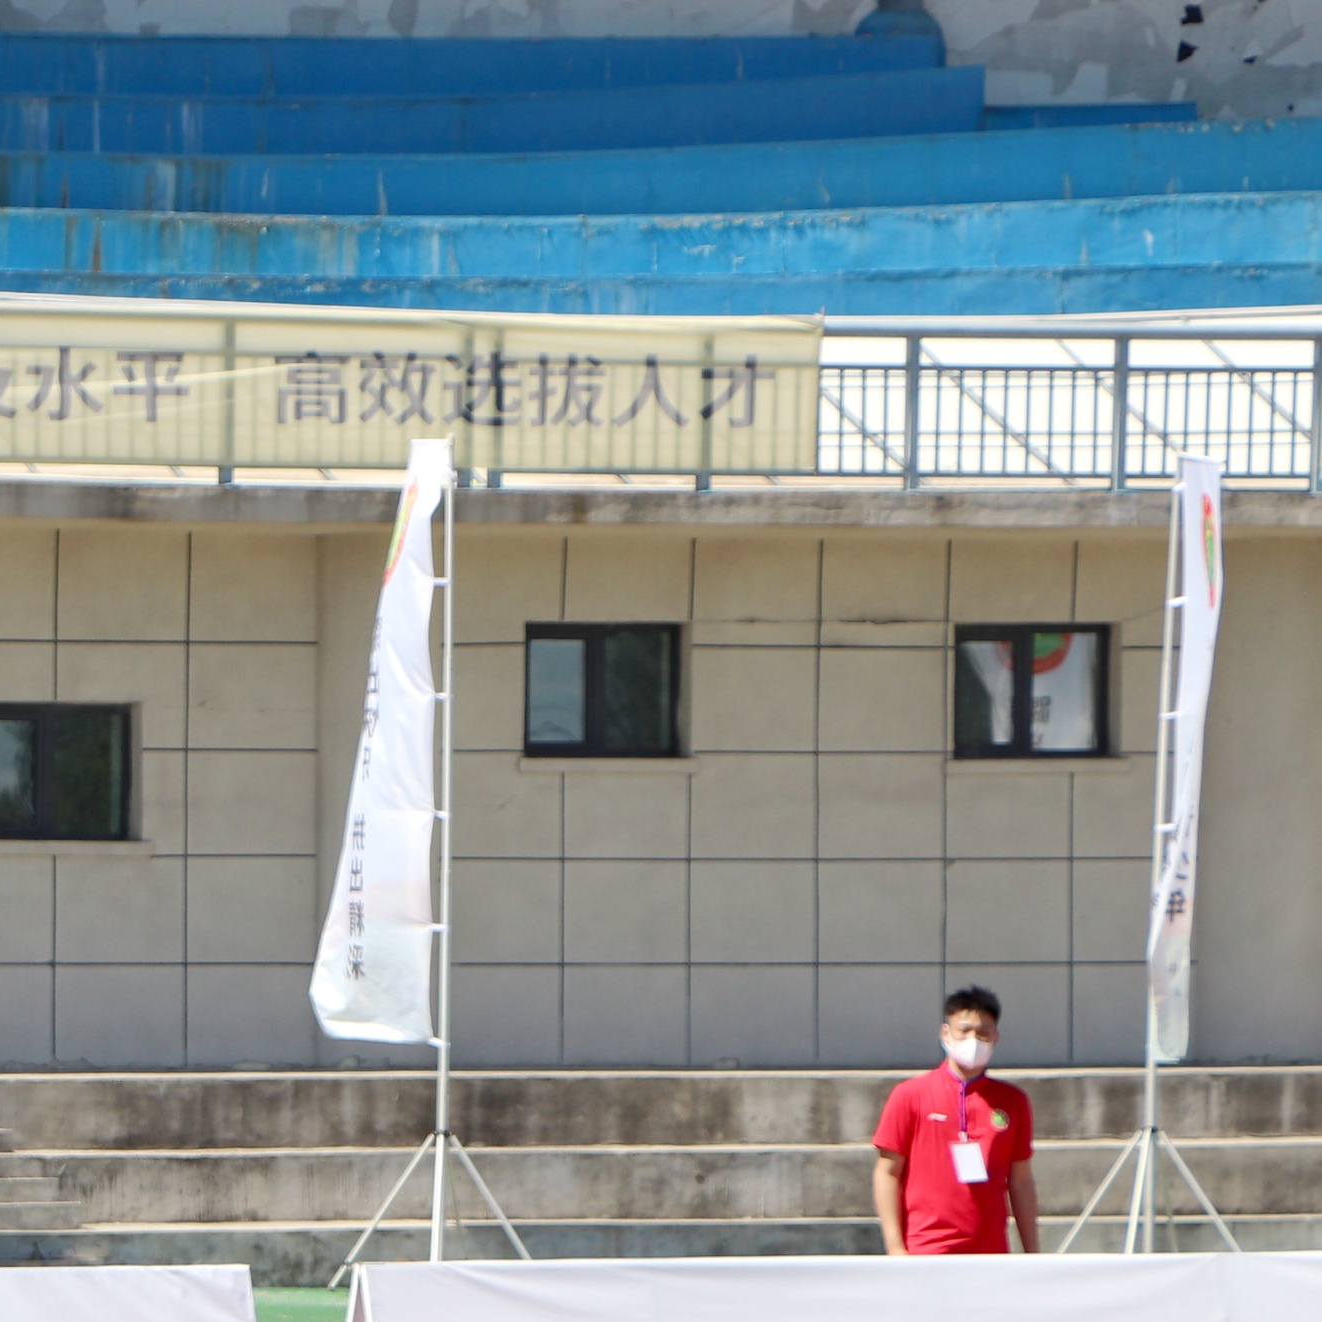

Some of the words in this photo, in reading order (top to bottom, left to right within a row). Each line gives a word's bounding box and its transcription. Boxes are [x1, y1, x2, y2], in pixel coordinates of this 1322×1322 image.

[275, 350, 777, 429] 高效选拔人才
